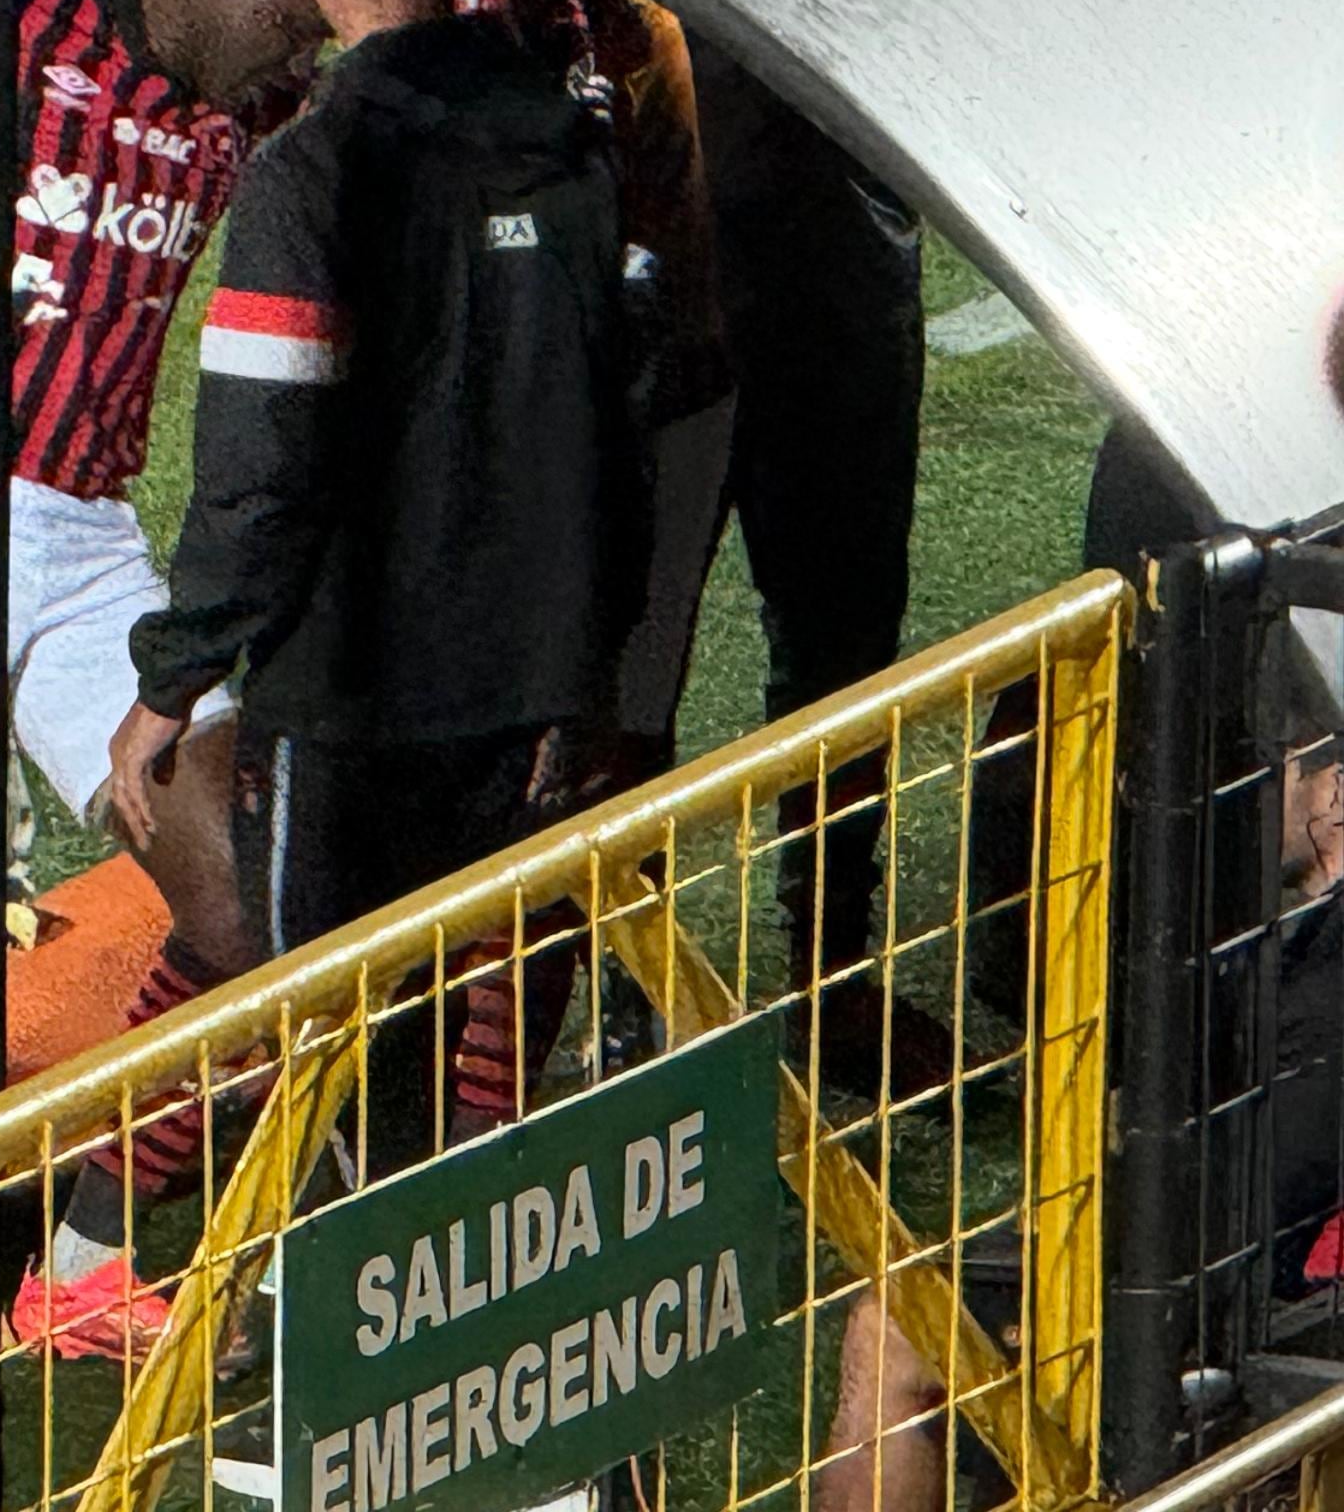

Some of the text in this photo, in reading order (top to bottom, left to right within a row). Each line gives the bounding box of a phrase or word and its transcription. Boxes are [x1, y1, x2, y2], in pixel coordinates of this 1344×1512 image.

[356, 1110, 704, 1357] SALIDA DE
[311, 1249, 746, 1512] EMERGENCIA
